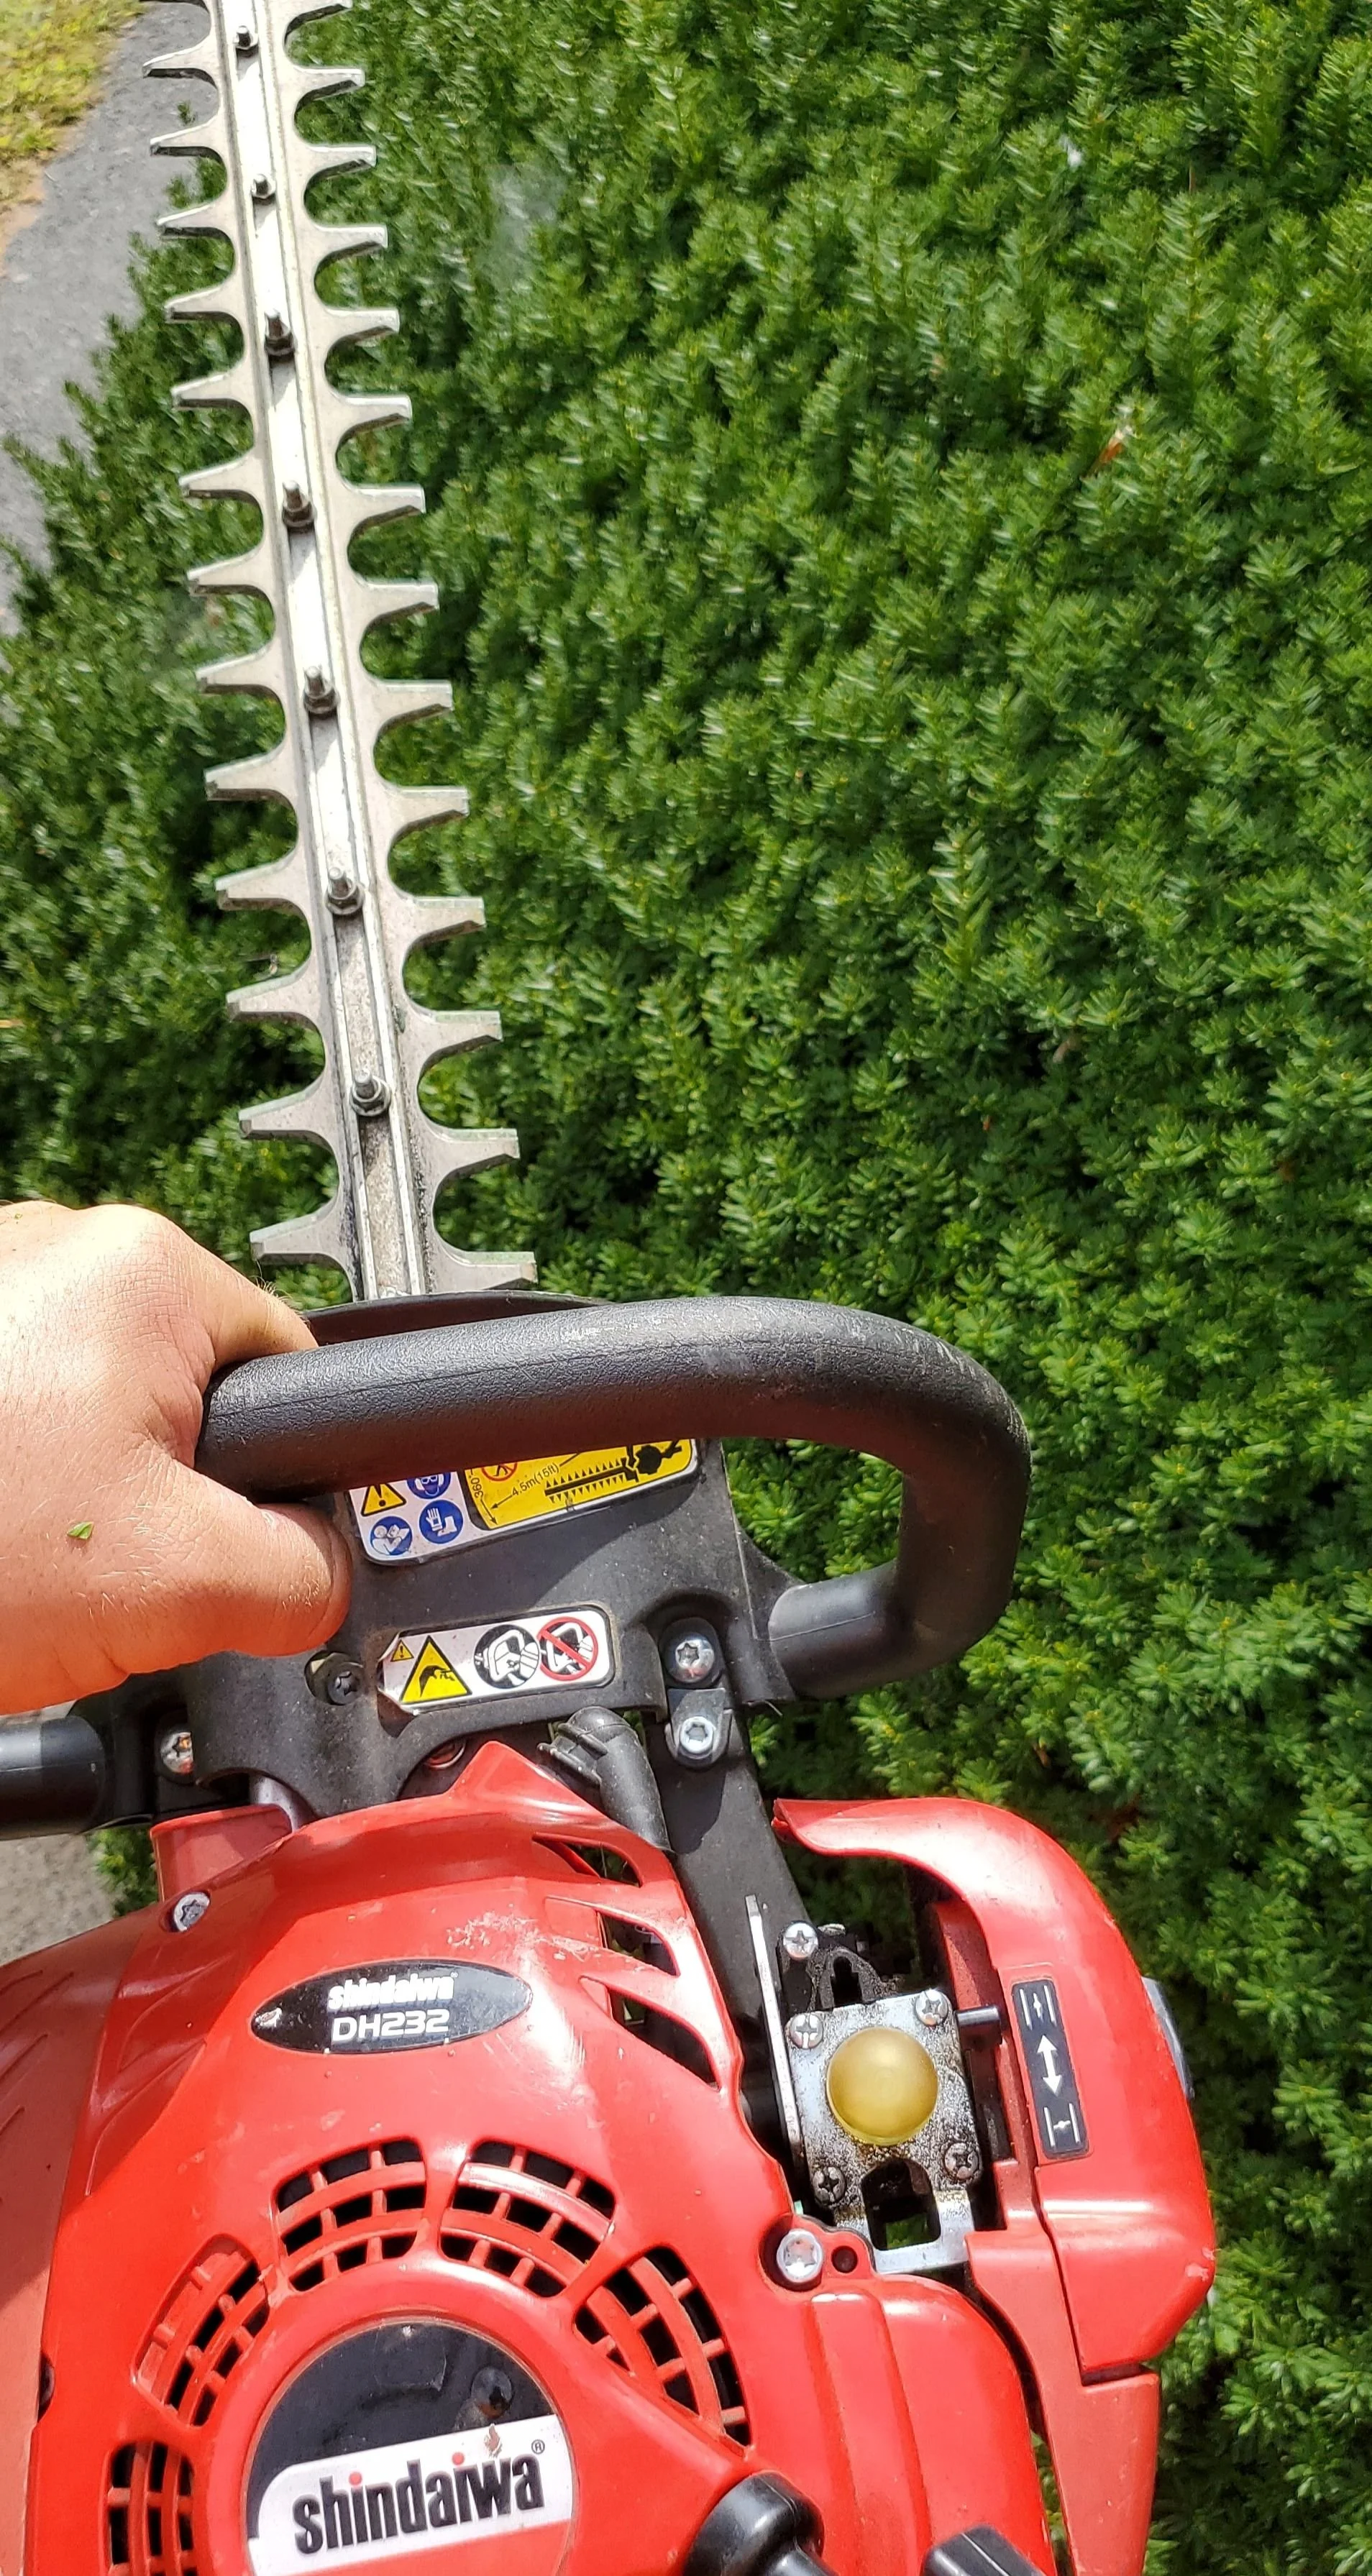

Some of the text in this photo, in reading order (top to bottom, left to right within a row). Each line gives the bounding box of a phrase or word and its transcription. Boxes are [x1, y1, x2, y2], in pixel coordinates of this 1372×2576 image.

[511, 1462, 559, 1496] 4.5m(15ft)
[331, 2008, 450, 2042] DH232
[292, 2452, 544, 2554] shindaiwa
